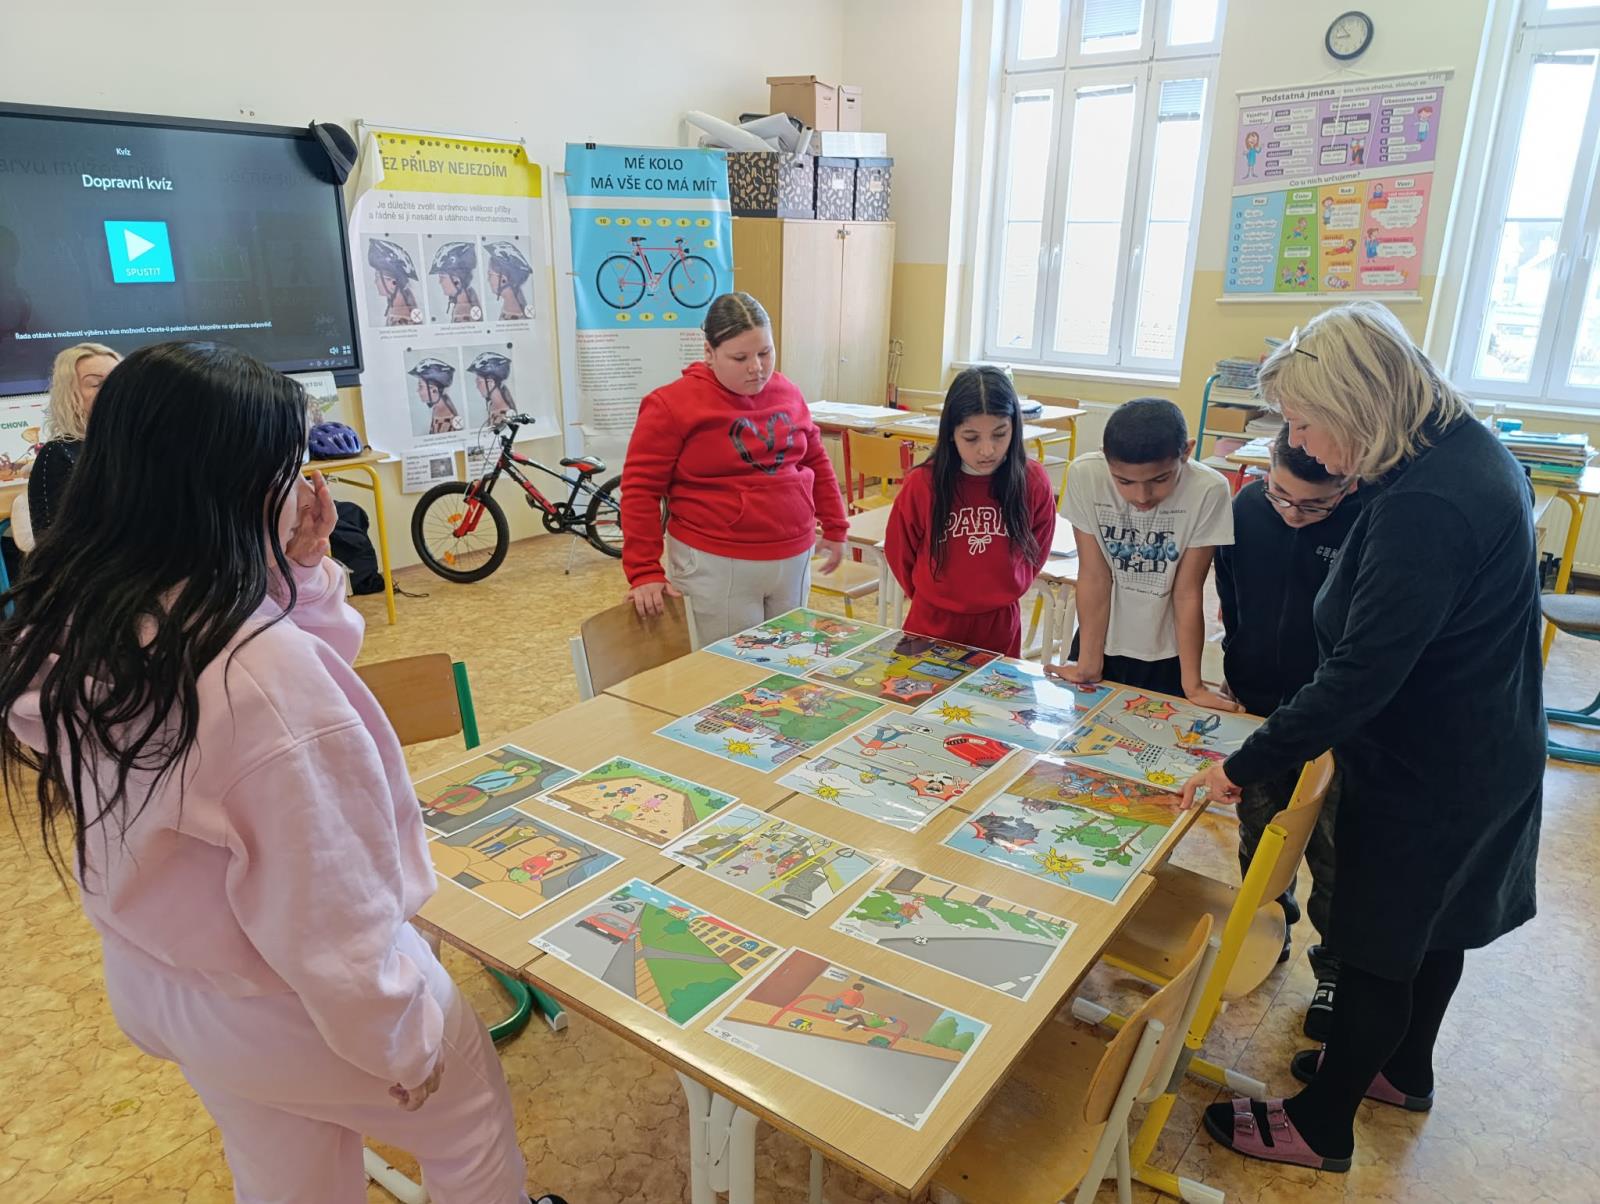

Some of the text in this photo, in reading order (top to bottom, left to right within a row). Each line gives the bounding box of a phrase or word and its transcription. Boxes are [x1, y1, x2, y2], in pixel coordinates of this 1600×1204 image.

[1261, 91, 1305, 104] Podstatná
[1307, 88, 1335, 100] jména
[116, 148, 131, 156] Kvíz
[382, 155, 508, 178] EZ PŘILBY NEJEZDÍM
[624, 155, 683, 171] MÉ KOLO
[82, 174, 173, 191] Dopravní kvíz
[591, 174, 717, 192] MÁ VŠE CO MÁ MÍT
[0, 420, 29, 430] CHOVA
[1315, 990, 1334, 1002] FI
